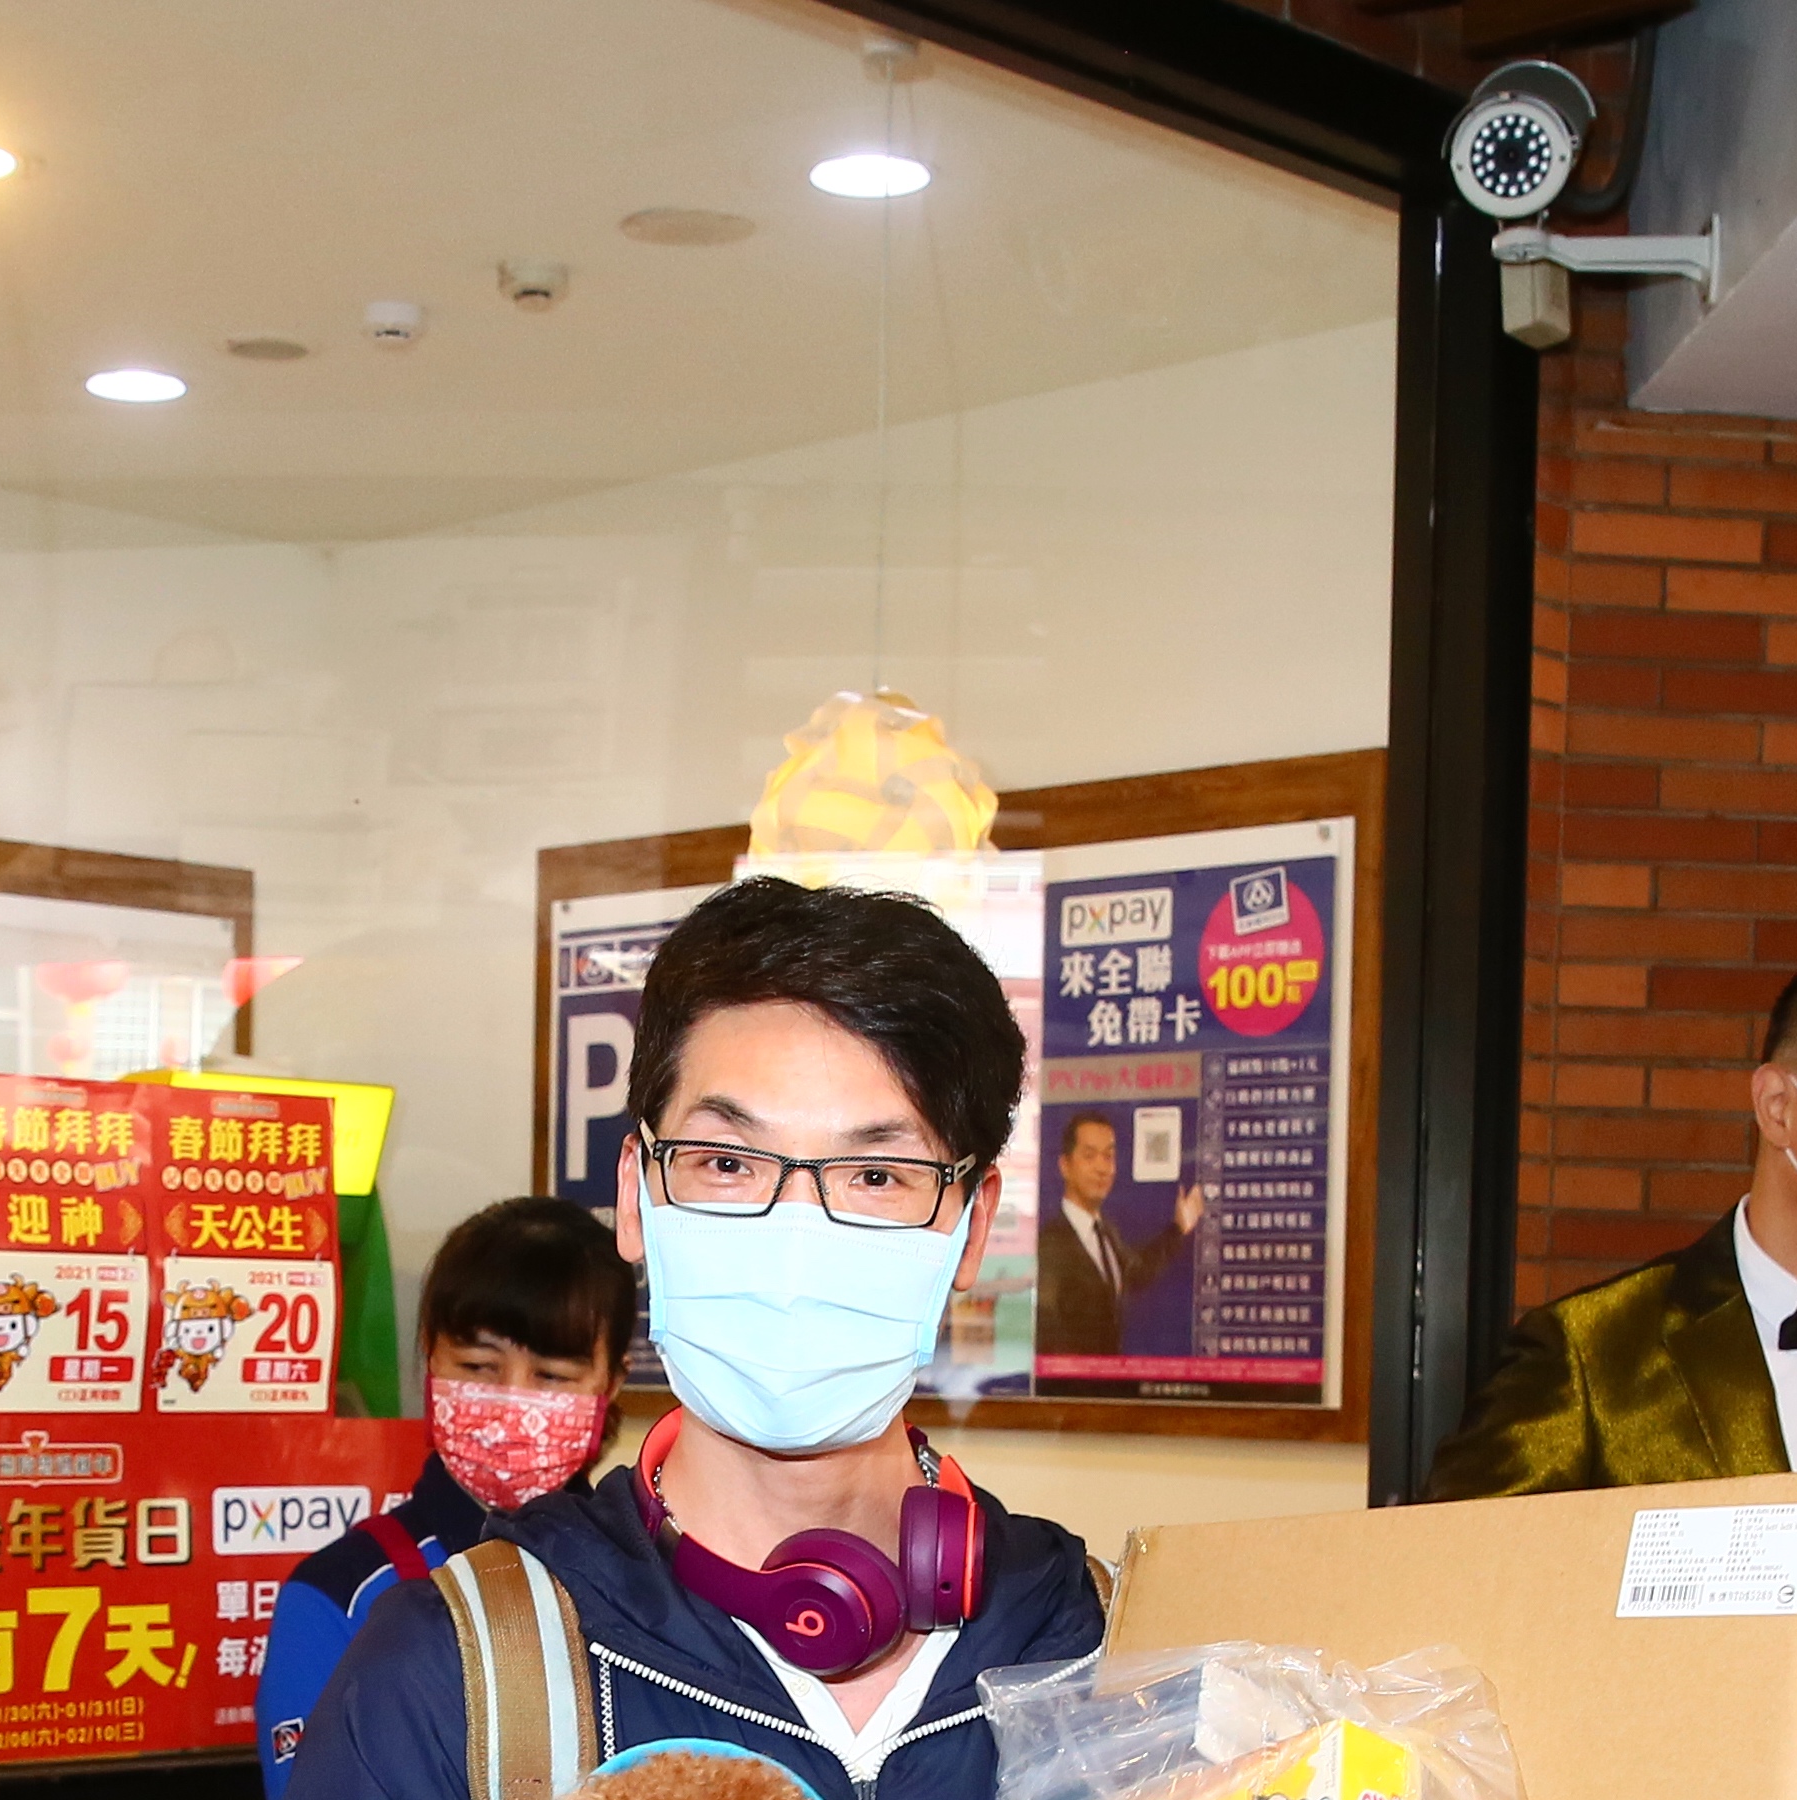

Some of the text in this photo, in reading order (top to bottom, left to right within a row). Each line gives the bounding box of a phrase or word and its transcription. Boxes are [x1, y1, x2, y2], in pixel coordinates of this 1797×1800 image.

[1059, 945, 1173, 998] 來全聯
[1208, 962, 1286, 1010] 100
[1087, 994, 1203, 1048] 免帶卡
[169, 1115, 323, 1166] 春節拜拜
[7, 1193, 104, 1247] 迎神
[190, 1204, 305, 1252] 天公生
[55, 1265, 93, 1281] 2021
[249, 1270, 283, 1286] 2021
[64, 1289, 129, 1351] 15
[254, 1293, 320, 1353] 20
[62, 1357, 120, 1381] 星期一
[253, 1360, 309, 1382] 星期六
[216, 1581, 280, 1622] 單日
